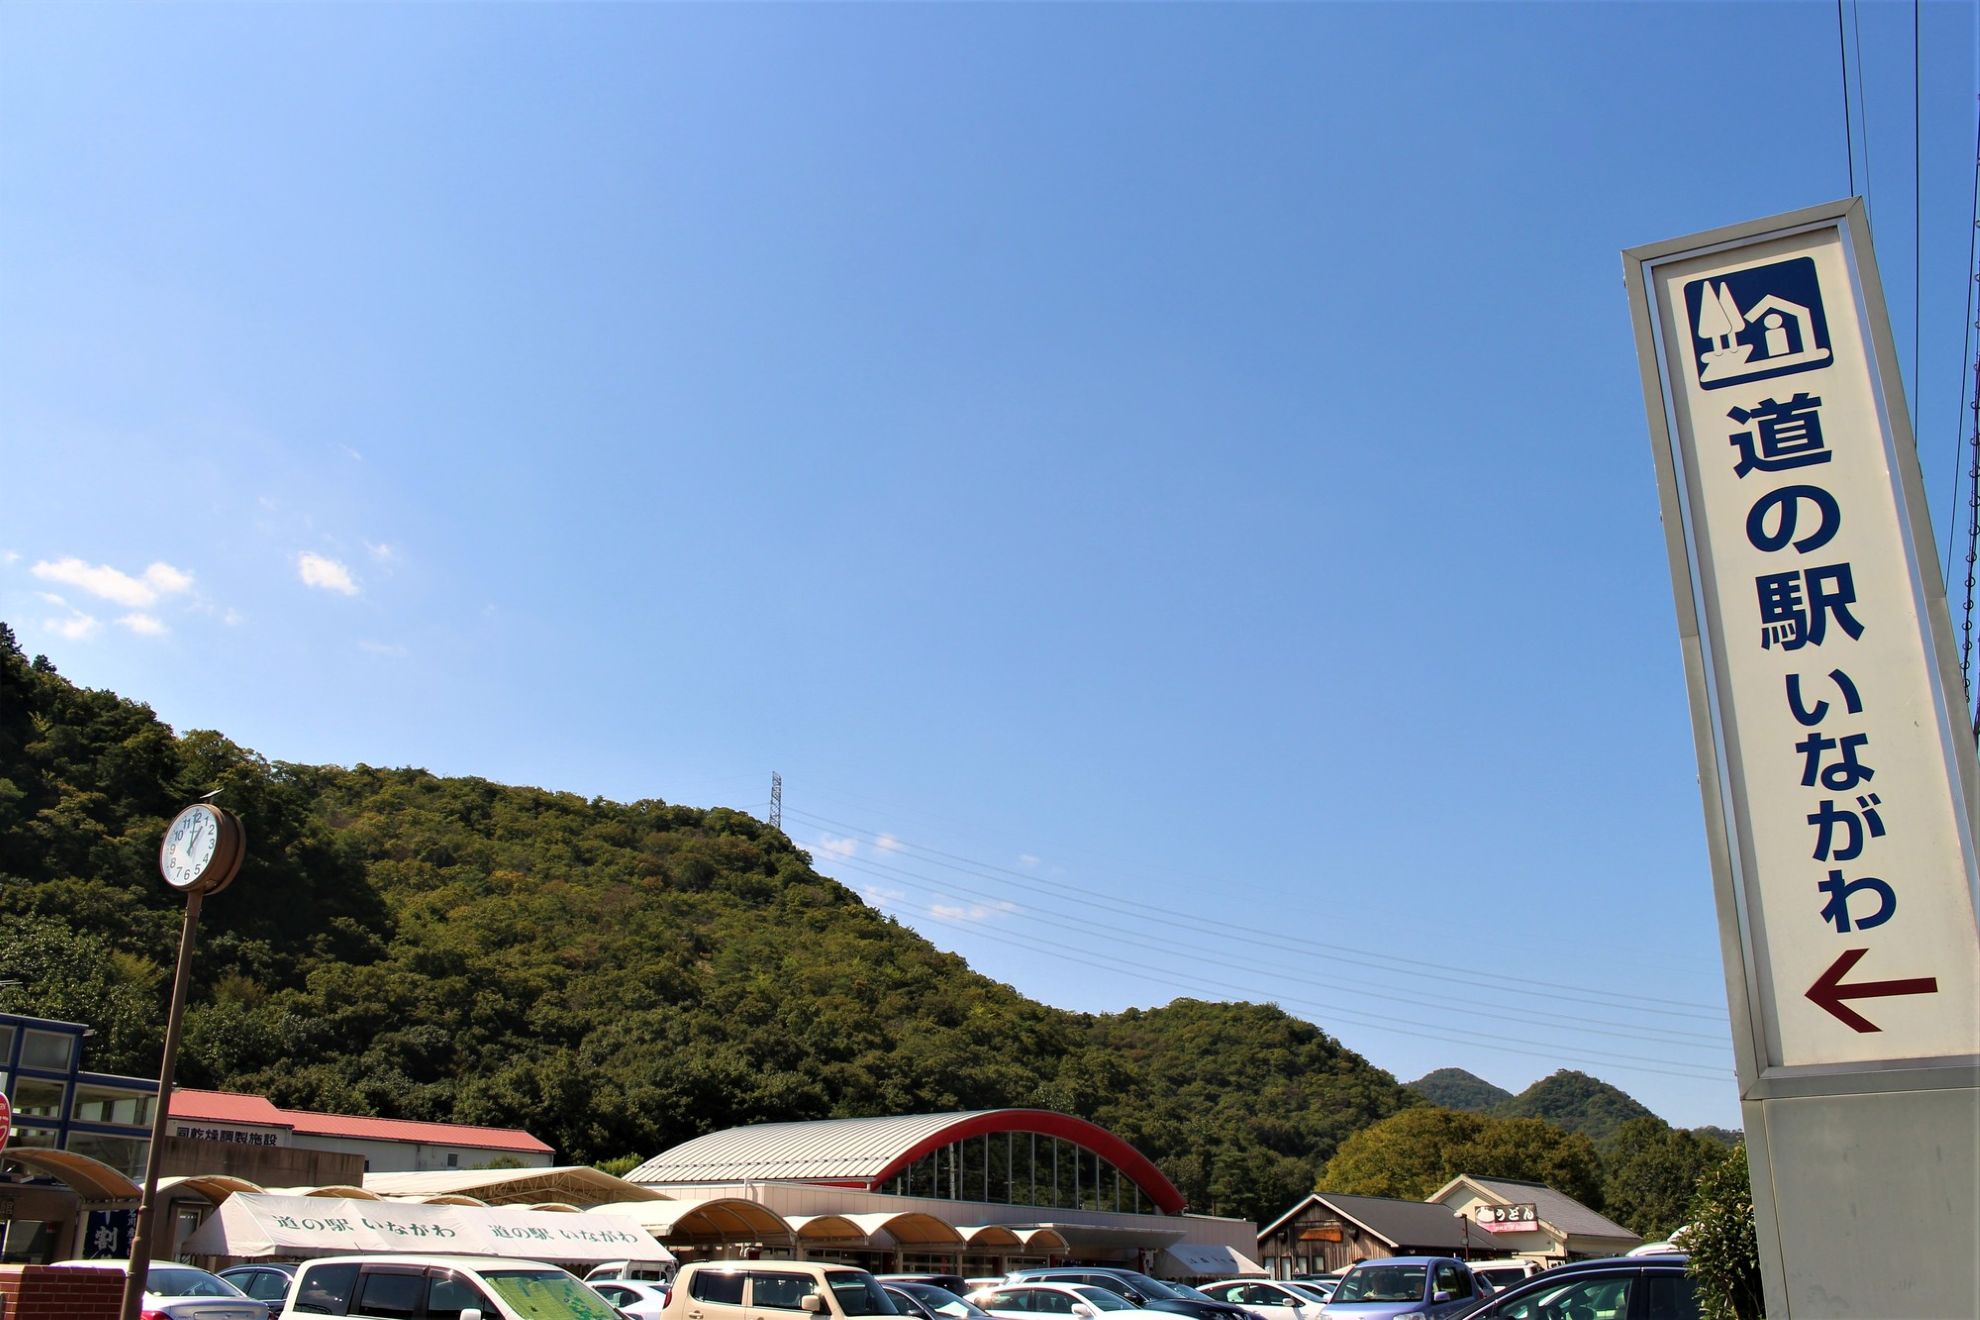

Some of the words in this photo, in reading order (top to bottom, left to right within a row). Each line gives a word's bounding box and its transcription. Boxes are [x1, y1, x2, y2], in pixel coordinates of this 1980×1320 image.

[1728, 393, 1864, 652] 道の駅
[1786, 669, 1896, 933] いながわ
[183, 819, 191, 829] 11
[175, 830, 184, 841] 10
[208, 825, 215, 835] 2
[170, 844, 176, 854] 9
[208, 839, 215, 849] 3
[170, 858, 176, 868] 8
[203, 853, 209, 864] 4
[176, 867, 183, 878] 7
[184, 869, 191, 880] 6
[194, 864, 201, 875] 5
[1496, 1207, 1534, 1221] うどん
[272, 1215, 355, 1232] 道の駅
[361, 1217, 456, 1238] いながわ
[488, 1224, 555, 1240] 道の駅
[560, 1229, 639, 1244] いながわ
